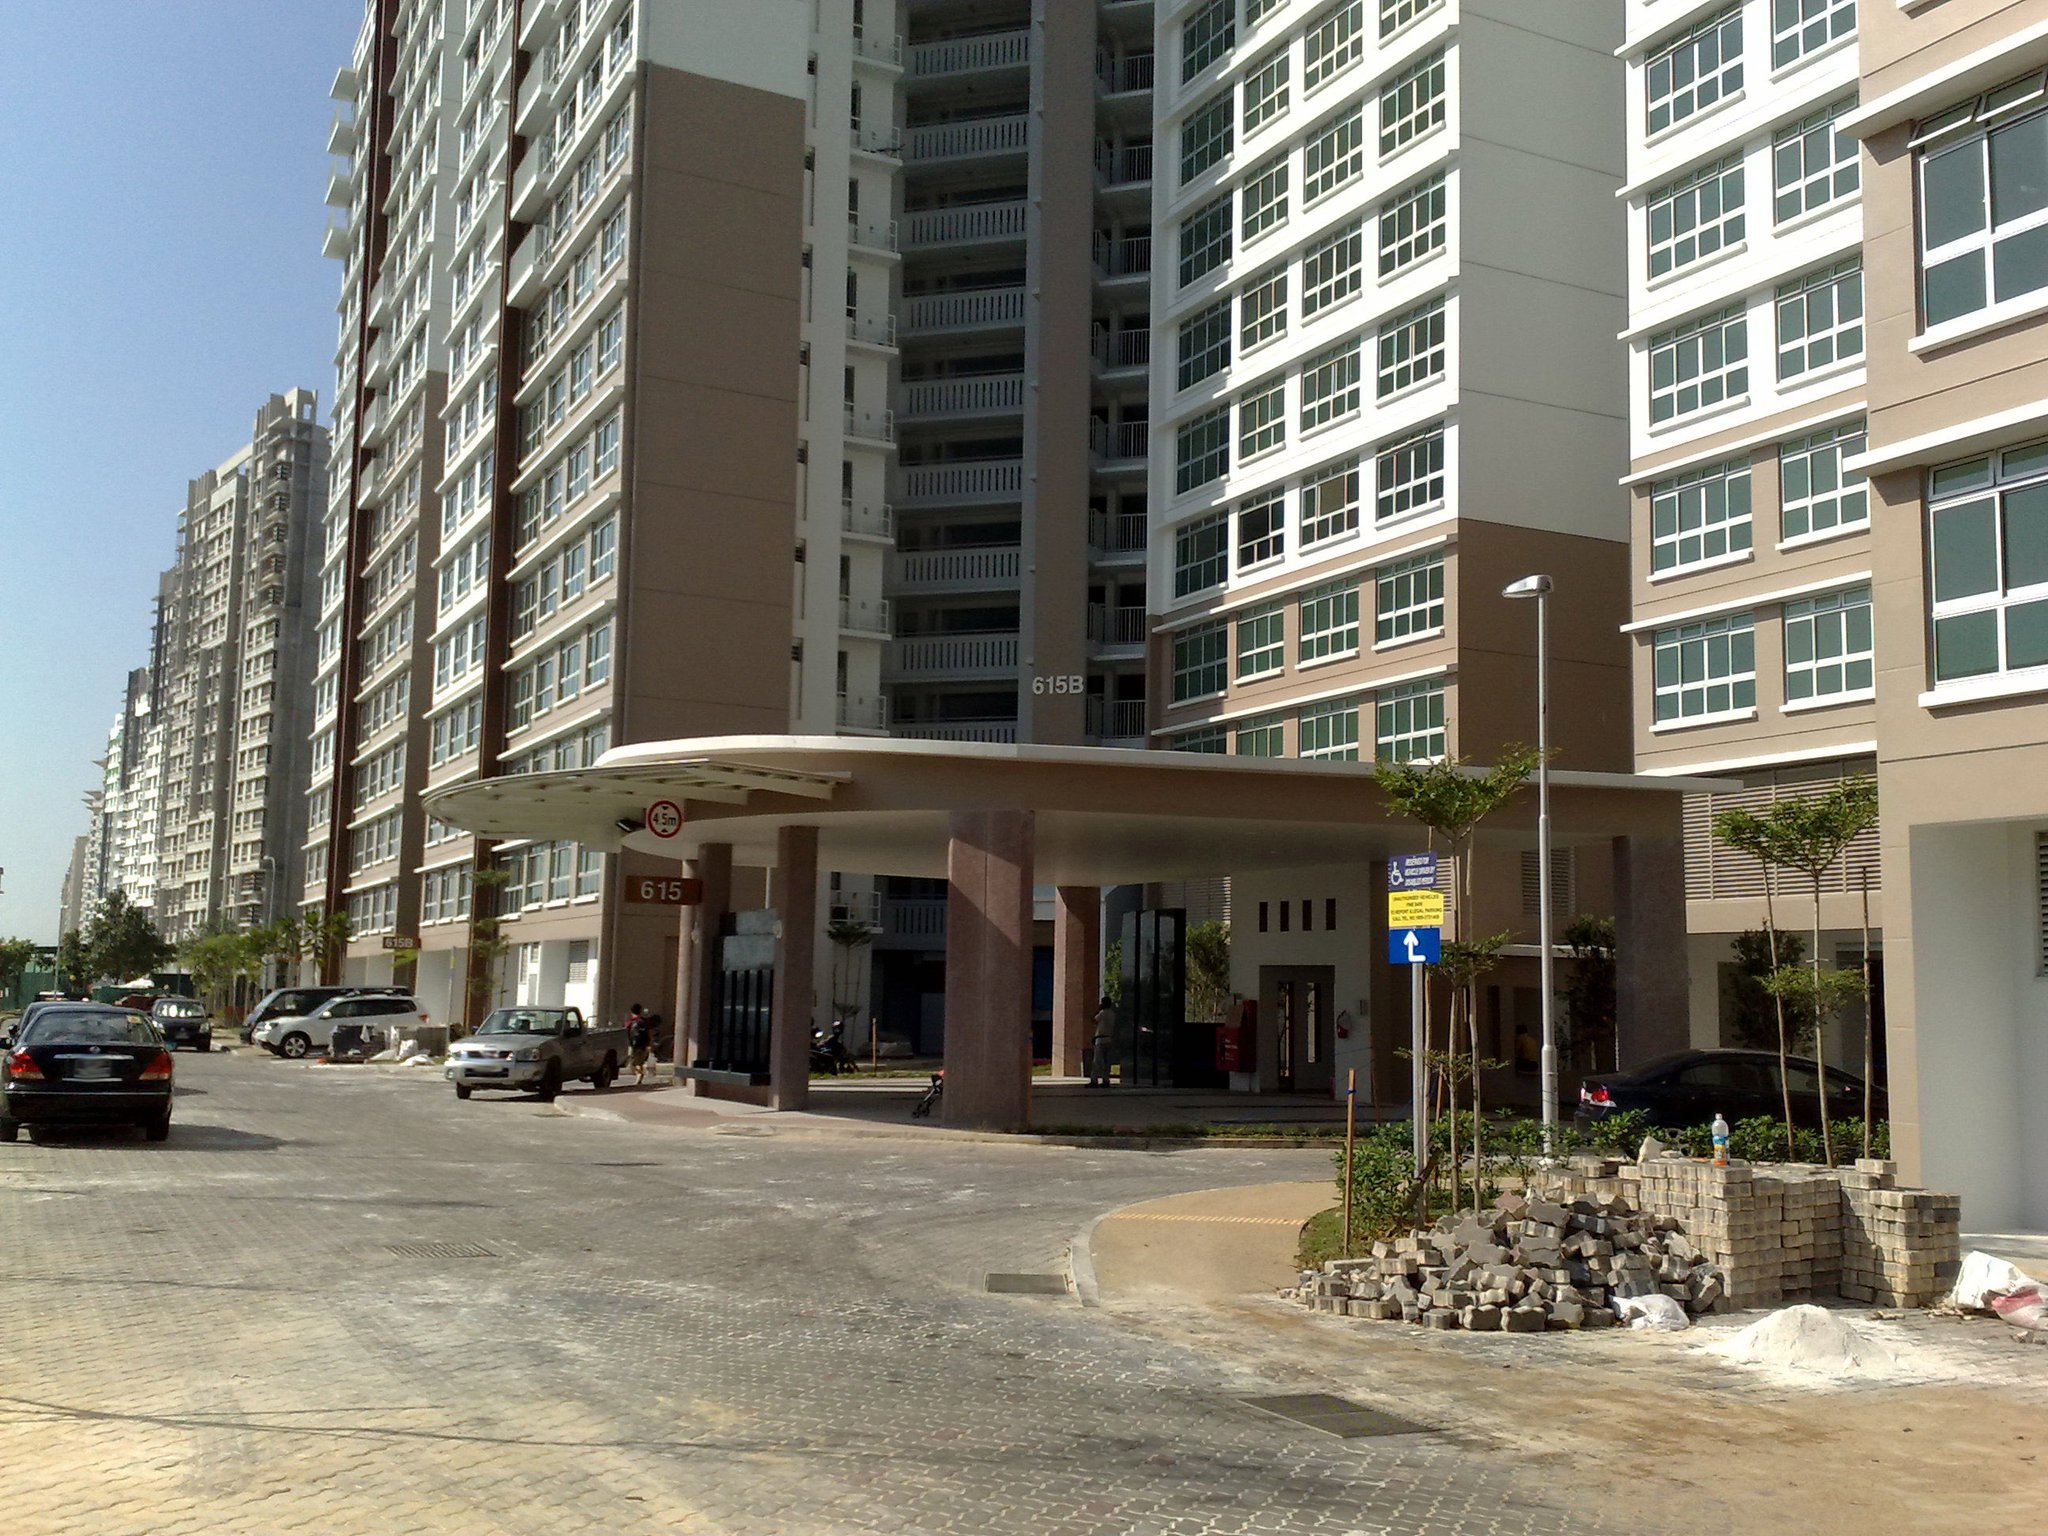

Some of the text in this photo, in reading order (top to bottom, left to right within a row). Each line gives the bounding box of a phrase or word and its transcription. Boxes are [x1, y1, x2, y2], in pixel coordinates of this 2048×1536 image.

[1032, 675, 1084, 695] 615B
[653, 812, 677, 826] 4.5m
[640, 881, 681, 900] 615
